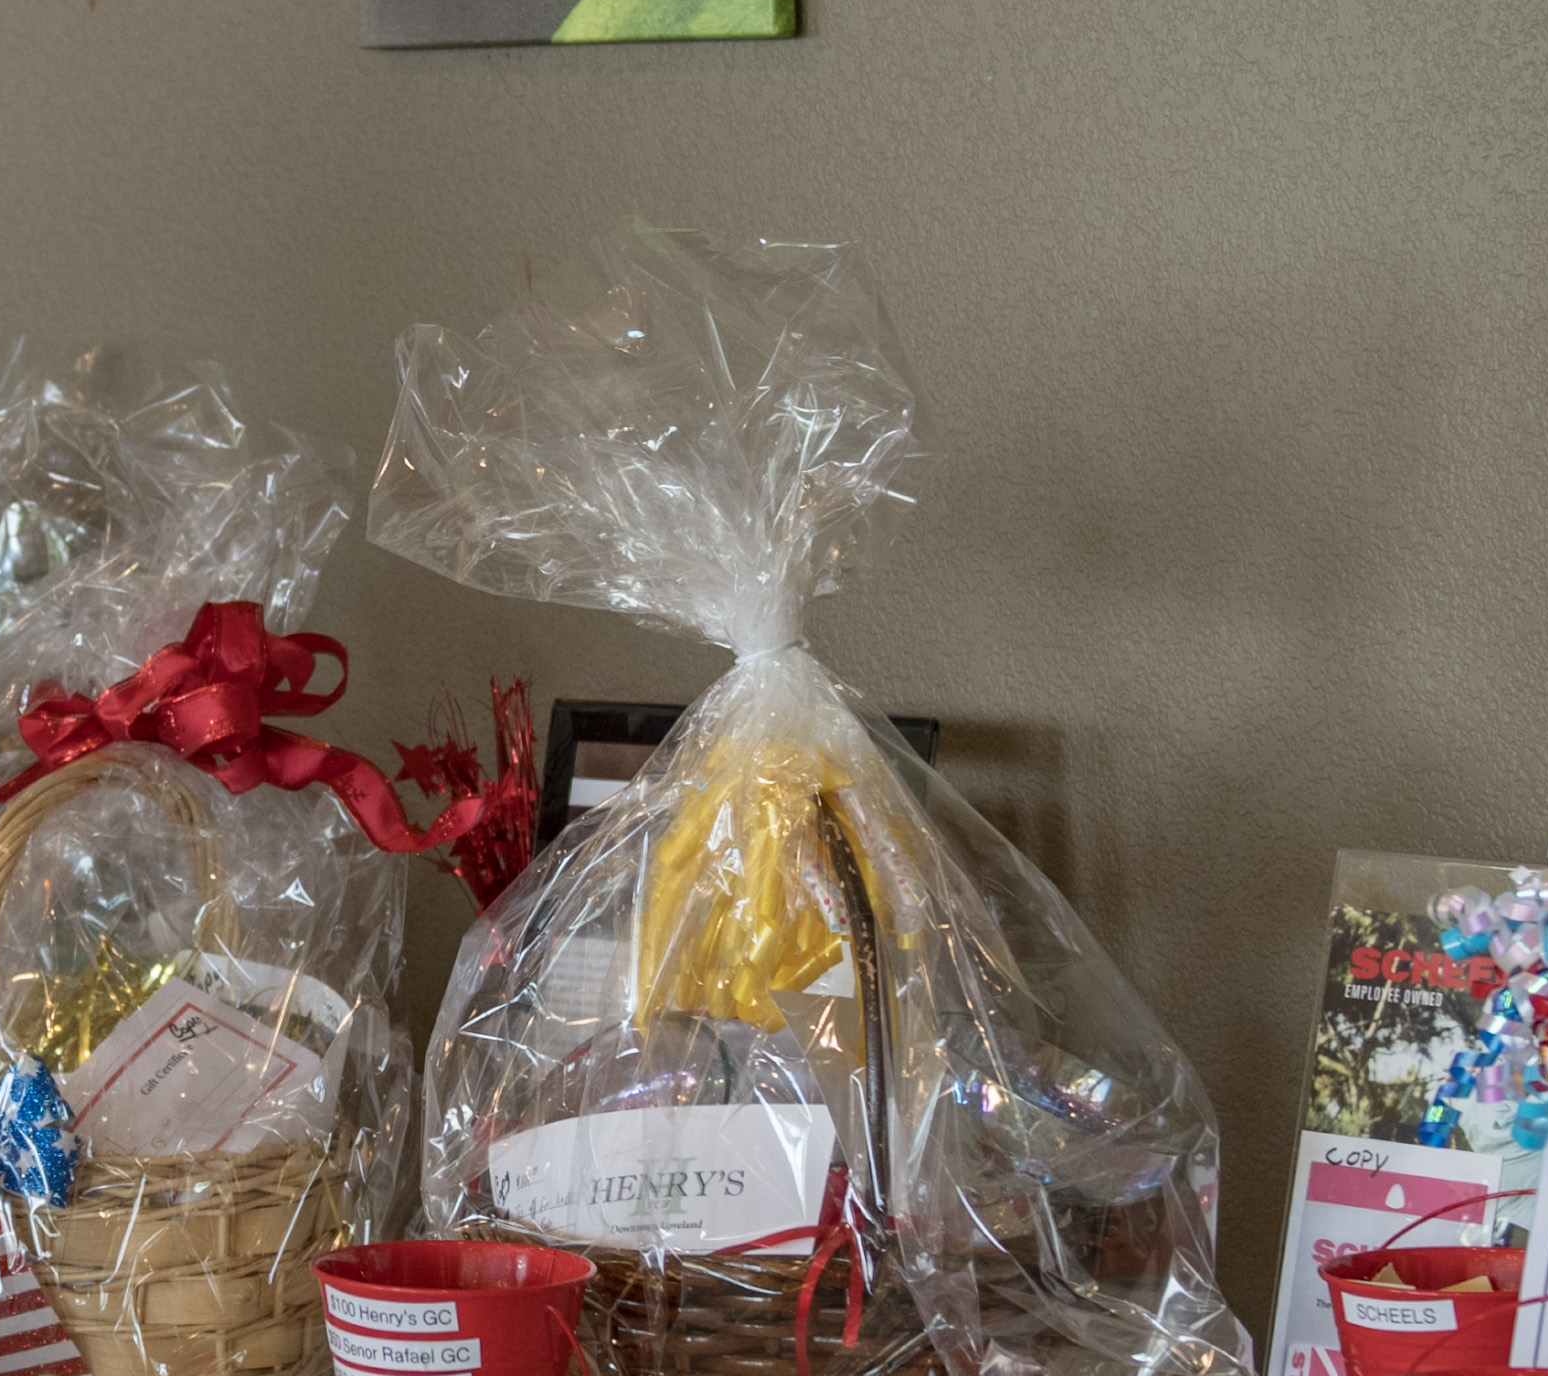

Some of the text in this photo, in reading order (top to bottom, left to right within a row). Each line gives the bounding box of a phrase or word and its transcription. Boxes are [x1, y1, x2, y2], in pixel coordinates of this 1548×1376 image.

[1344, 983, 1444, 1007] EMPLOYEE OWNED
[140, 1075, 160, 1097] Gift
[589, 1169, 746, 1205] HENRY'S
[330, 1294, 452, 1327] $100 Henry's GC
[1357, 1303, 1437, 1325] SCHEELS
[343, 1337, 470, 1365] Senor Rafael GC
